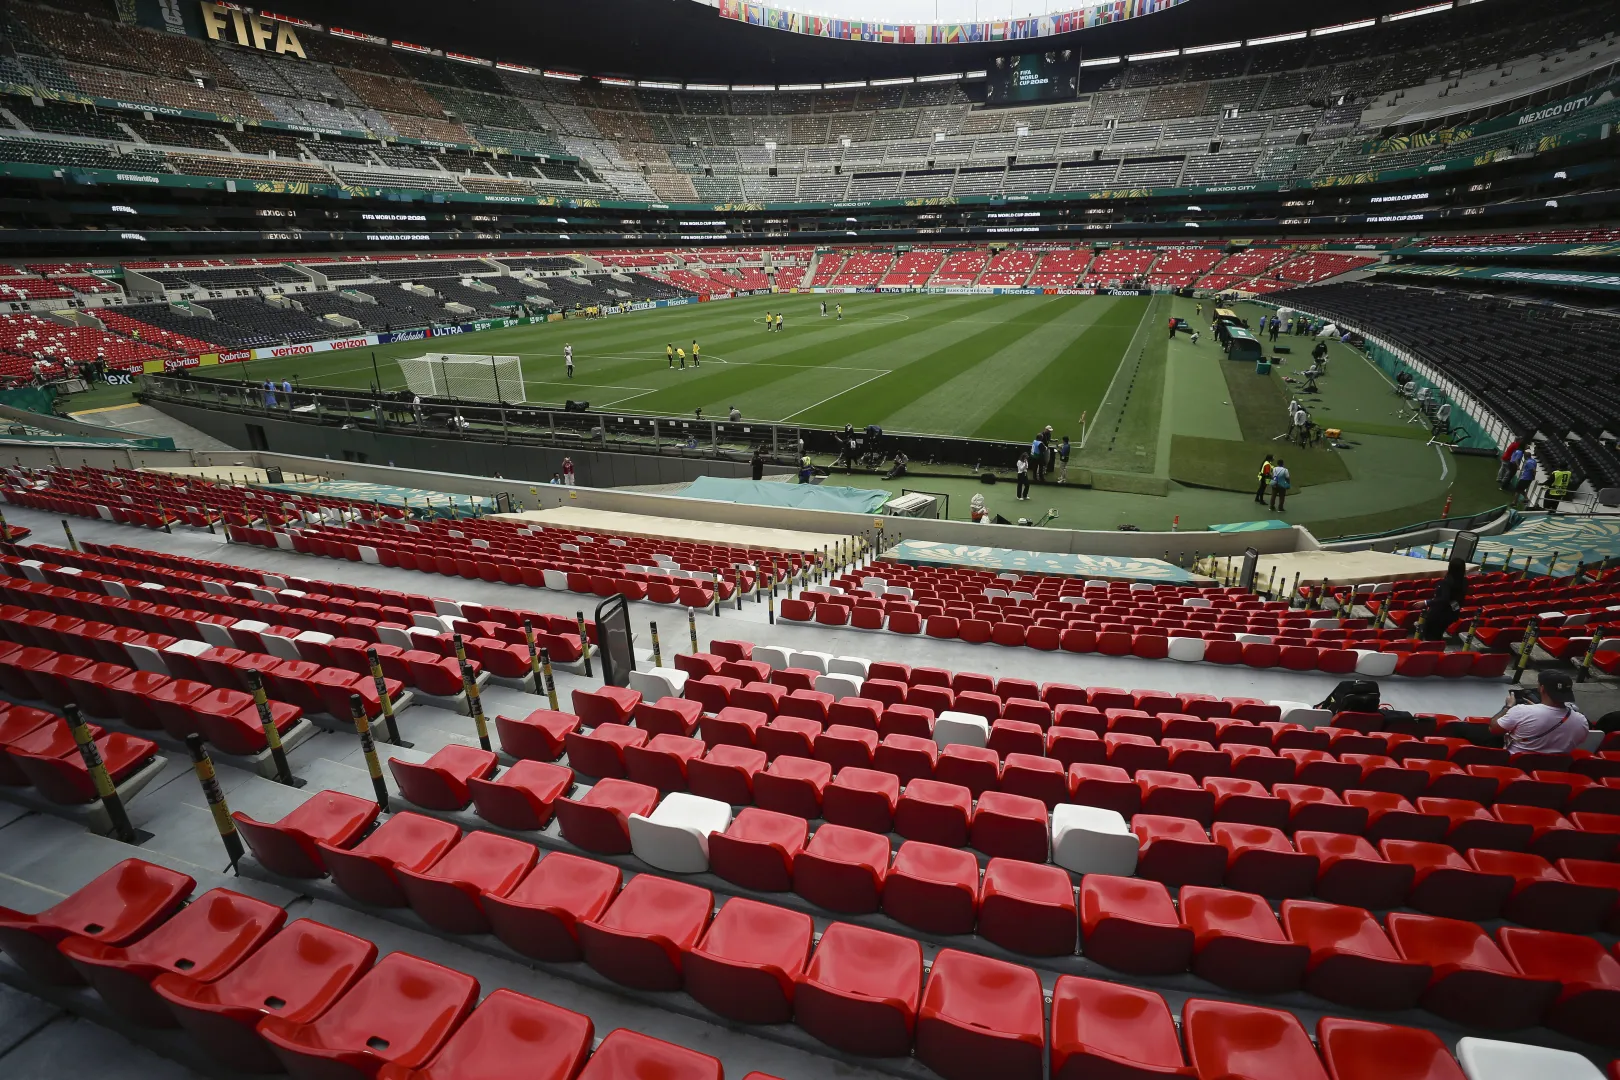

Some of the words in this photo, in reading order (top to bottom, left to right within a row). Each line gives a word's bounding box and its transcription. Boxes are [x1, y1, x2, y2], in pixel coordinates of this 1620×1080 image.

[200, 1, 307, 59] FIFA
[117, 102, 158, 112] MEXICO
[160, 107, 182, 115] CITY
[1518, 105, 1562, 125] MEXICO
[1564, 96, 1592, 112] CITY
[433, 326, 463, 336] ULTRA
[271, 344, 313, 356] verizon
[330, 338, 367, 350] verizon
[219, 351, 250, 363] Sabritas
